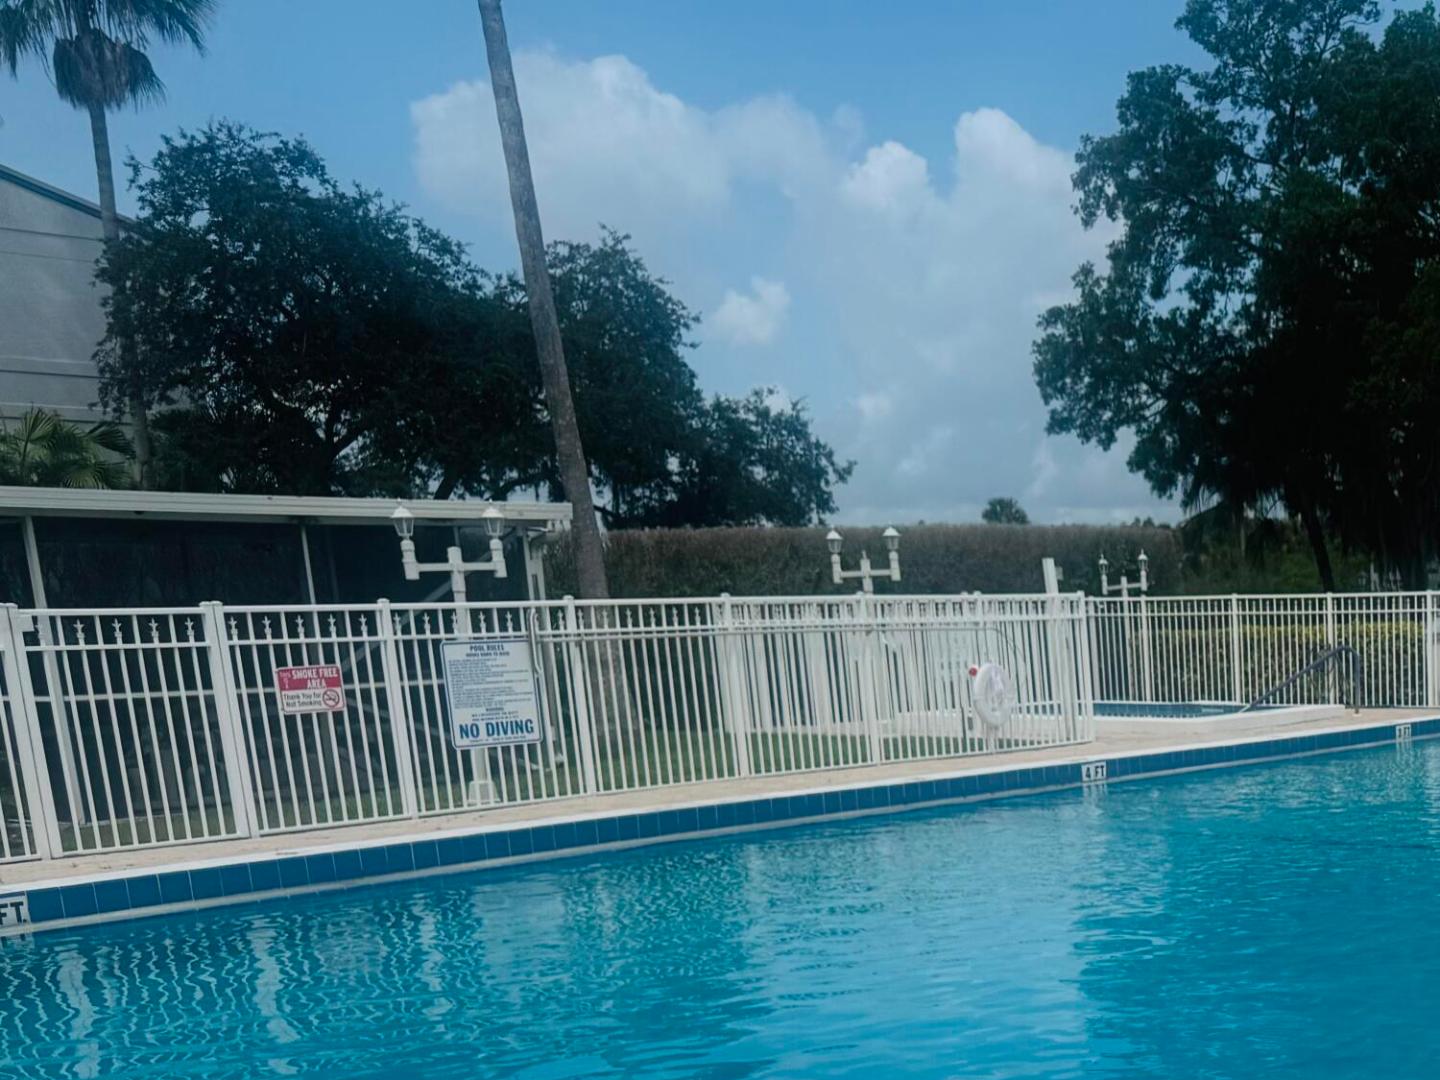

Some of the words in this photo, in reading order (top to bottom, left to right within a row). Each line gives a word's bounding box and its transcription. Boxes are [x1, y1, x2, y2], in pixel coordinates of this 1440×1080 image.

[470, 644, 485, 652] POOL
[486, 643, 504, 651] RULES
[291, 669, 318, 679] SMOKE
[318, 667, 338, 678] FREE
[306, 678, 327, 689] AREA
[283, 692, 301, 700] Thank
[302, 692, 312, 700] You
[297, 699, 322, 708] Smoking
[458, 723, 480, 740] NO
[485, 718, 534, 737] DIVING
[1085, 766, 1091, 778] 4
[1094, 765, 1105, 777] FT
